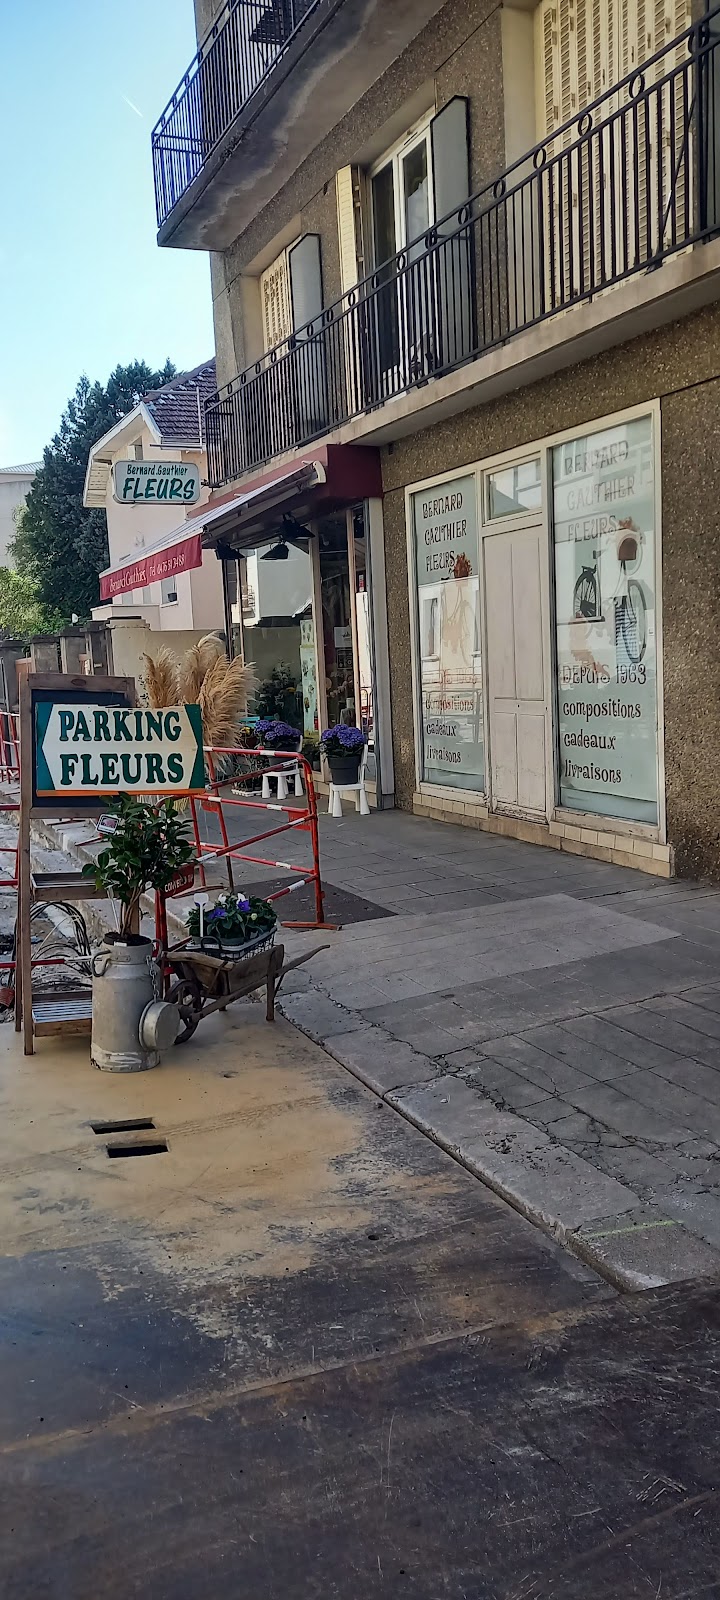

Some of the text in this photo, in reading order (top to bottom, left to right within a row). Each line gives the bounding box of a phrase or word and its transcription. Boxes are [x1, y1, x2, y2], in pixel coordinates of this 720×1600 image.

[122, 477, 196, 500] FLEURS
[566, 474, 636, 511] GAUTHIER
[422, 492, 463, 519] BERNARD
[424, 519, 467, 546] GAUTHIER
[567, 514, 618, 543] FLEURS
[425, 550, 456, 572] FLEURS
[562, 663, 647, 685] DEPUIS 1963
[562, 698, 642, 722] compositions
[57, 709, 182, 742] PARKING
[426, 719, 457, 737] cadeaux
[563, 728, 617, 751] cadeaux
[426, 744, 462, 764] livraisons
[59, 752, 184, 786] FLEURS
[564, 759, 623, 784] livraisons
